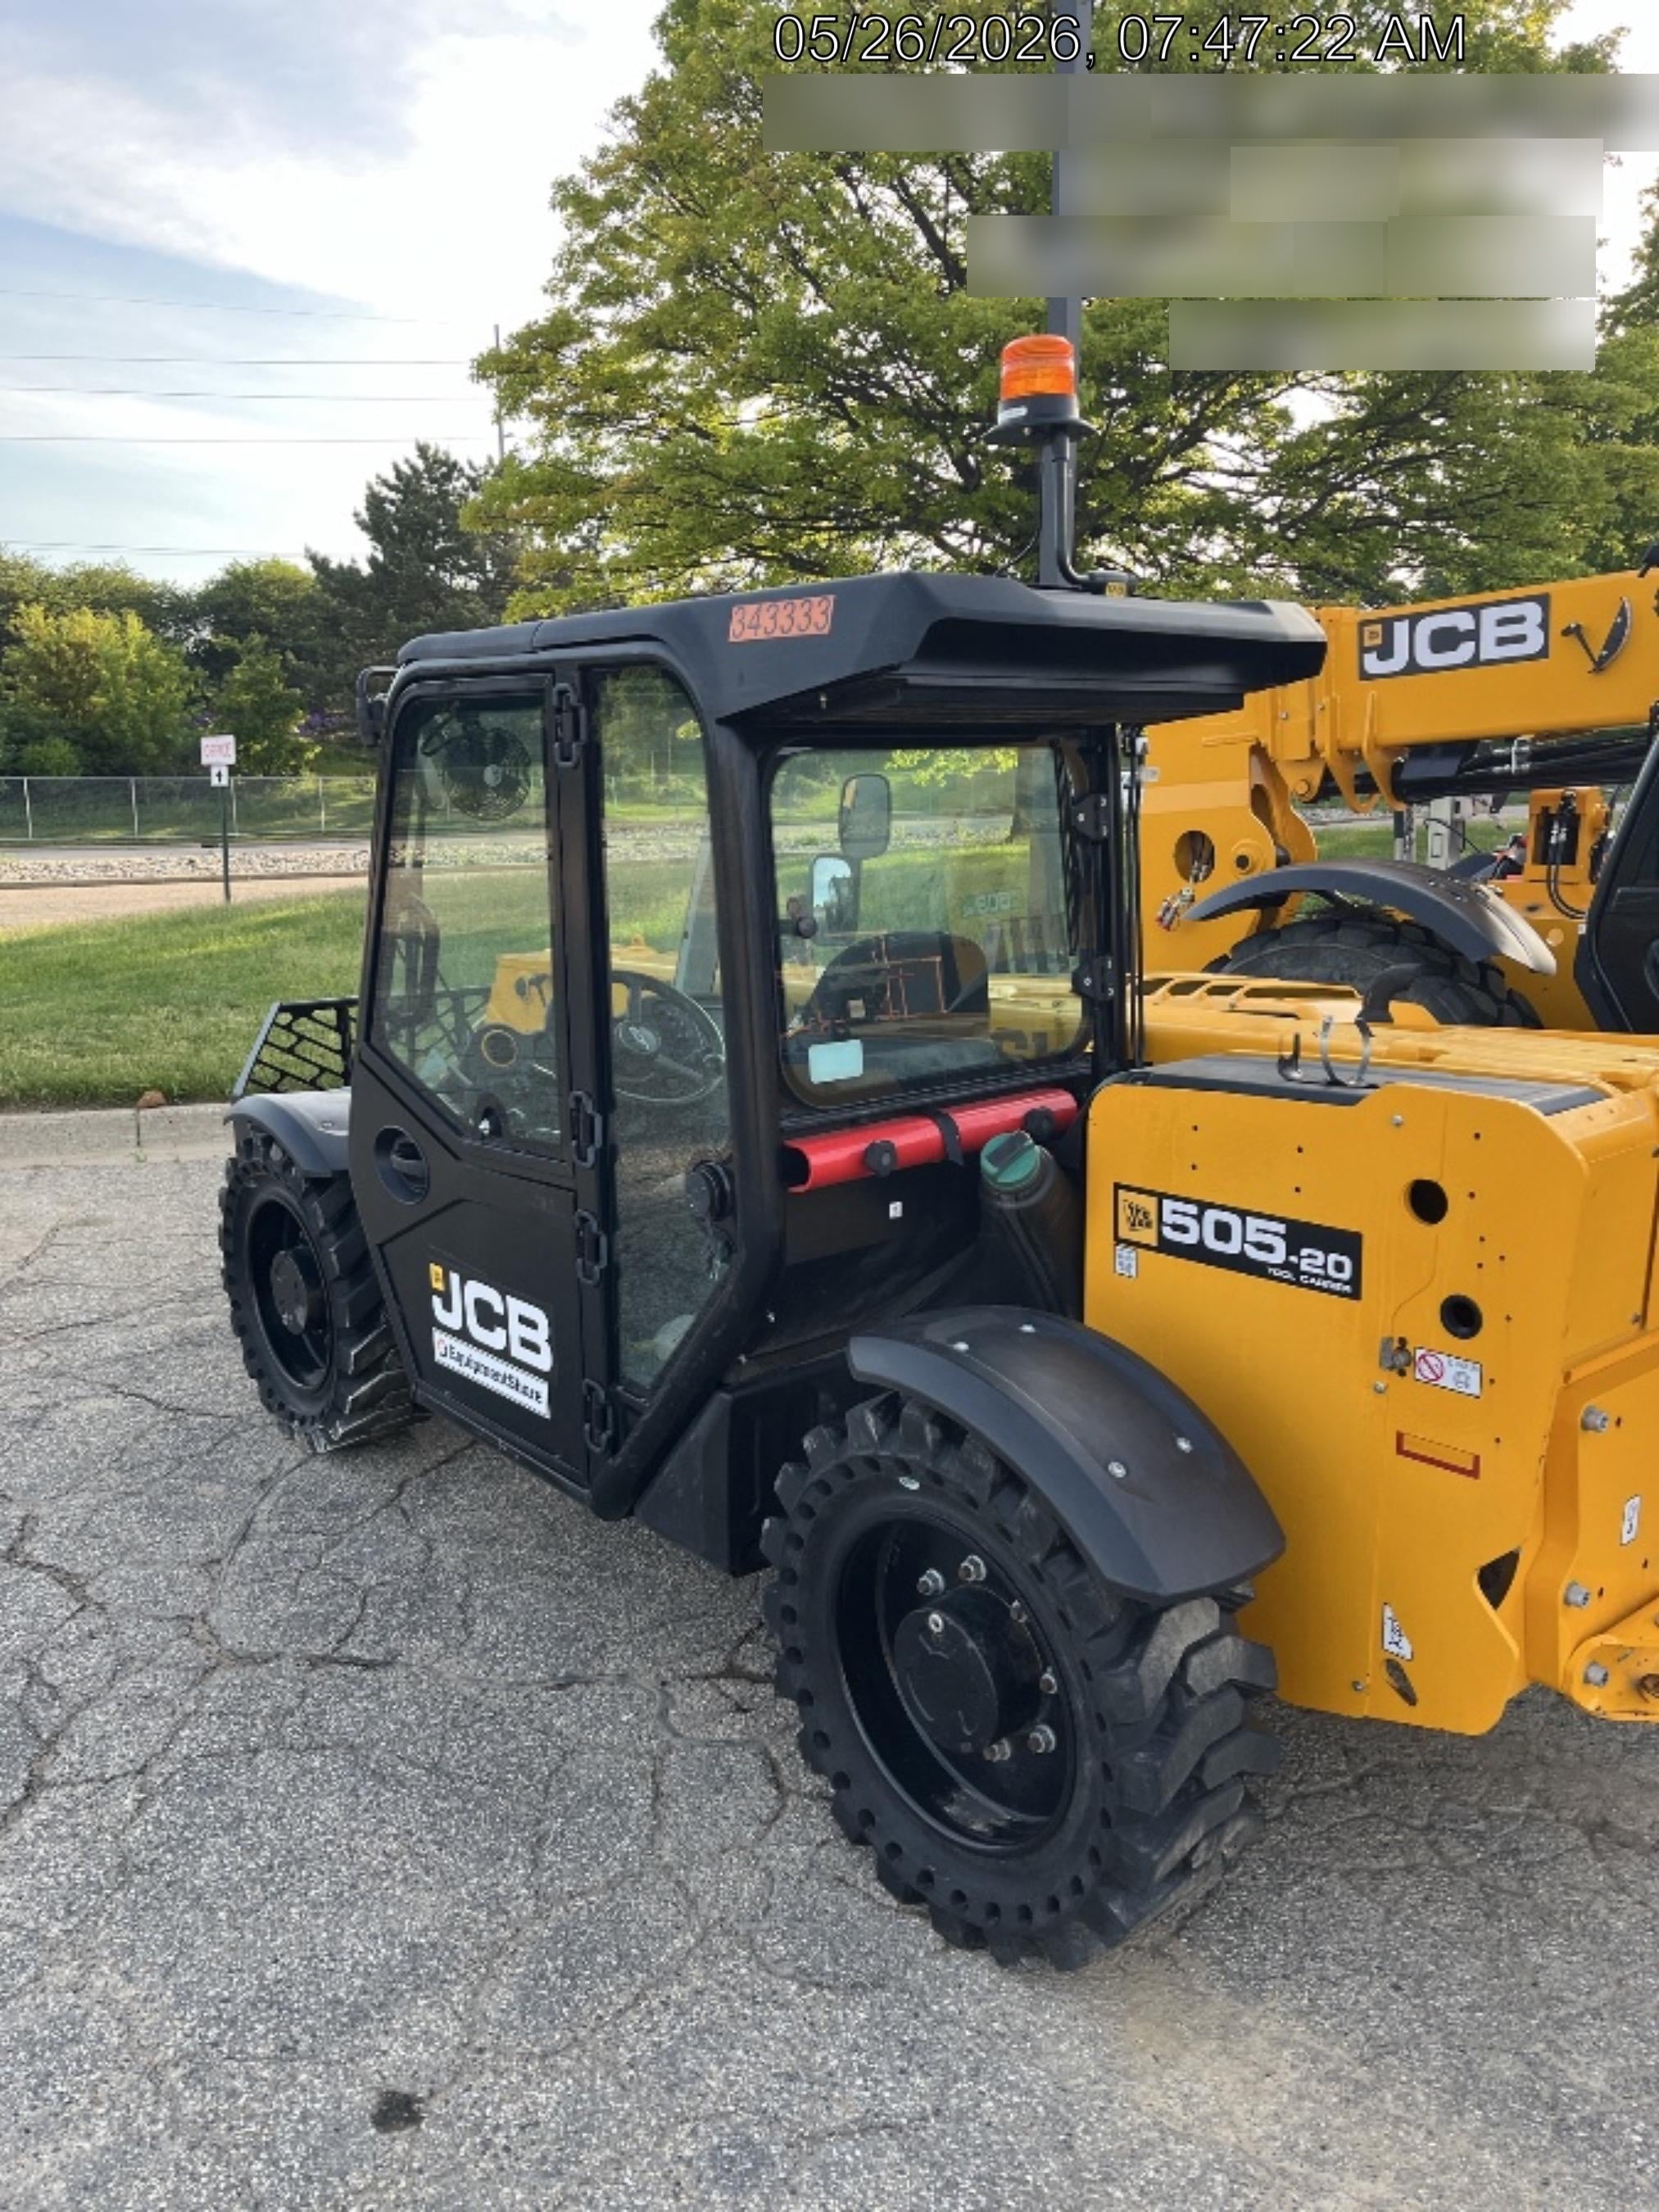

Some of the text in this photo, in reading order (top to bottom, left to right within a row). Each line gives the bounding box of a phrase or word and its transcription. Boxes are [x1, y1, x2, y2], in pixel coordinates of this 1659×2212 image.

[732, 596, 831, 640] 343333
[1363, 602, 1545, 675] JCB
[431, 1270, 554, 1372] JCB
